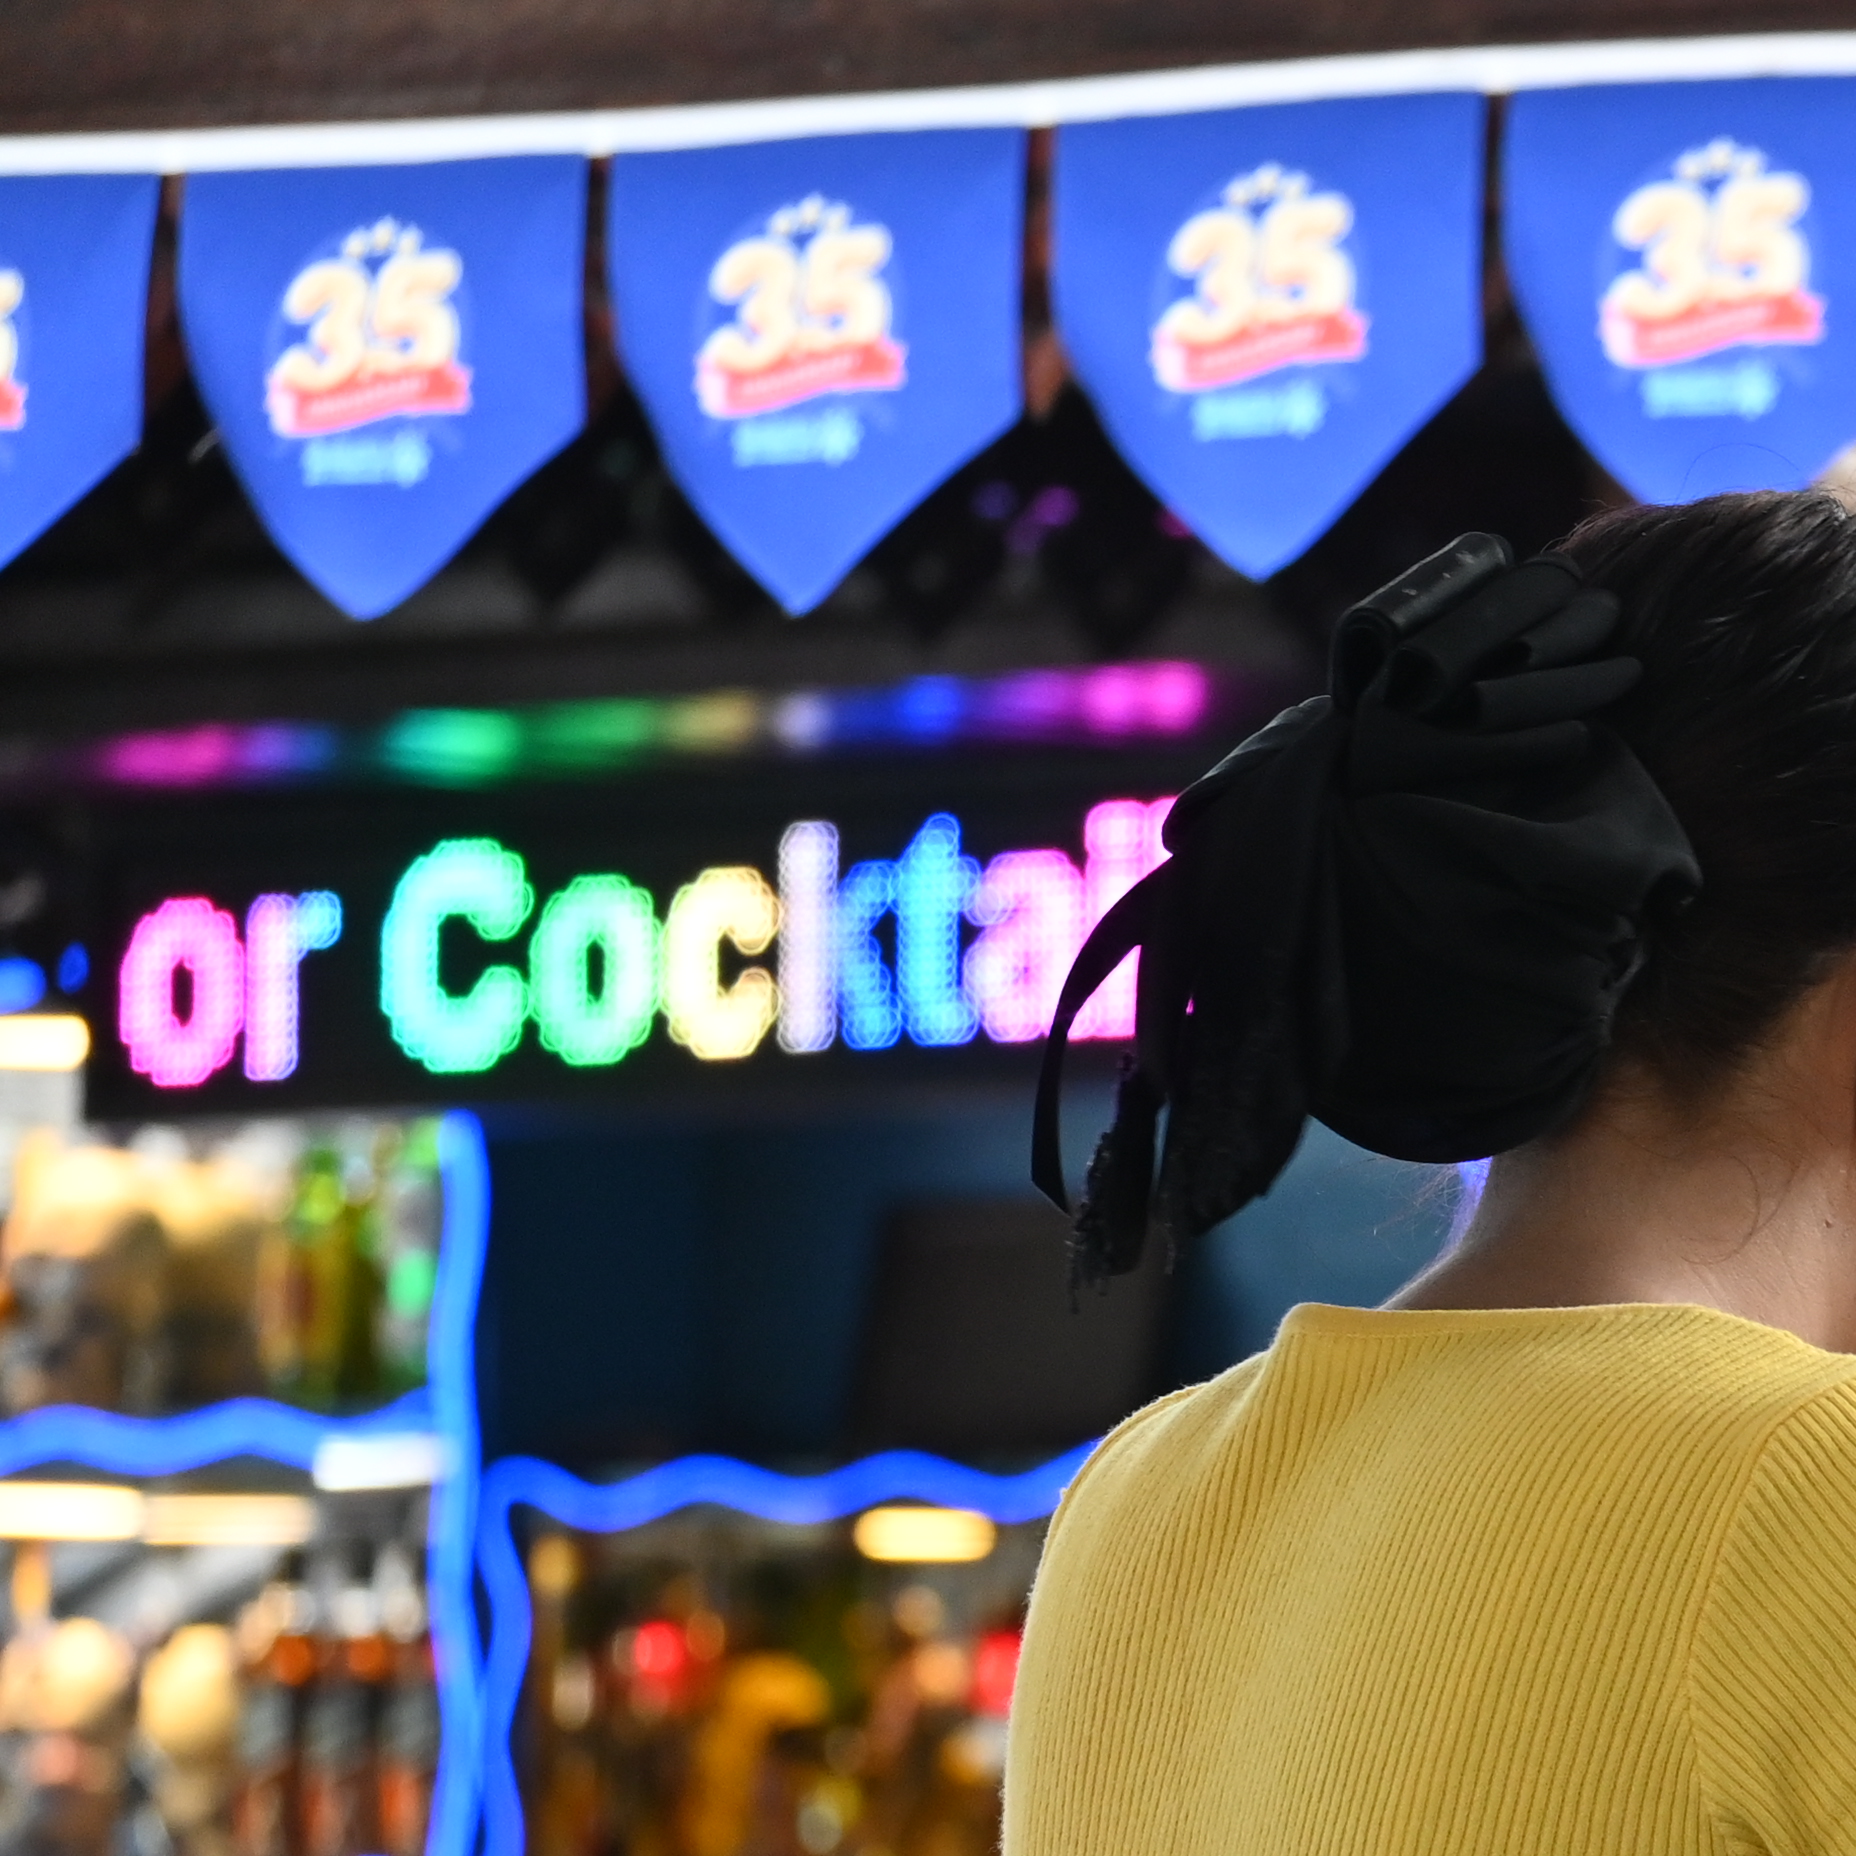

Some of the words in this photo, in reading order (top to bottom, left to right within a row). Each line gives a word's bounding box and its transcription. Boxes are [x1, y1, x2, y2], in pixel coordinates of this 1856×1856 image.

[276, 247, 463, 390] 35
[700, 223, 895, 376] 35
[1159, 189, 1355, 343] 35
[1602, 170, 1811, 321] 35
[118, 890, 343, 1089] or
[379, 795, 1177, 1075] Cocktai
